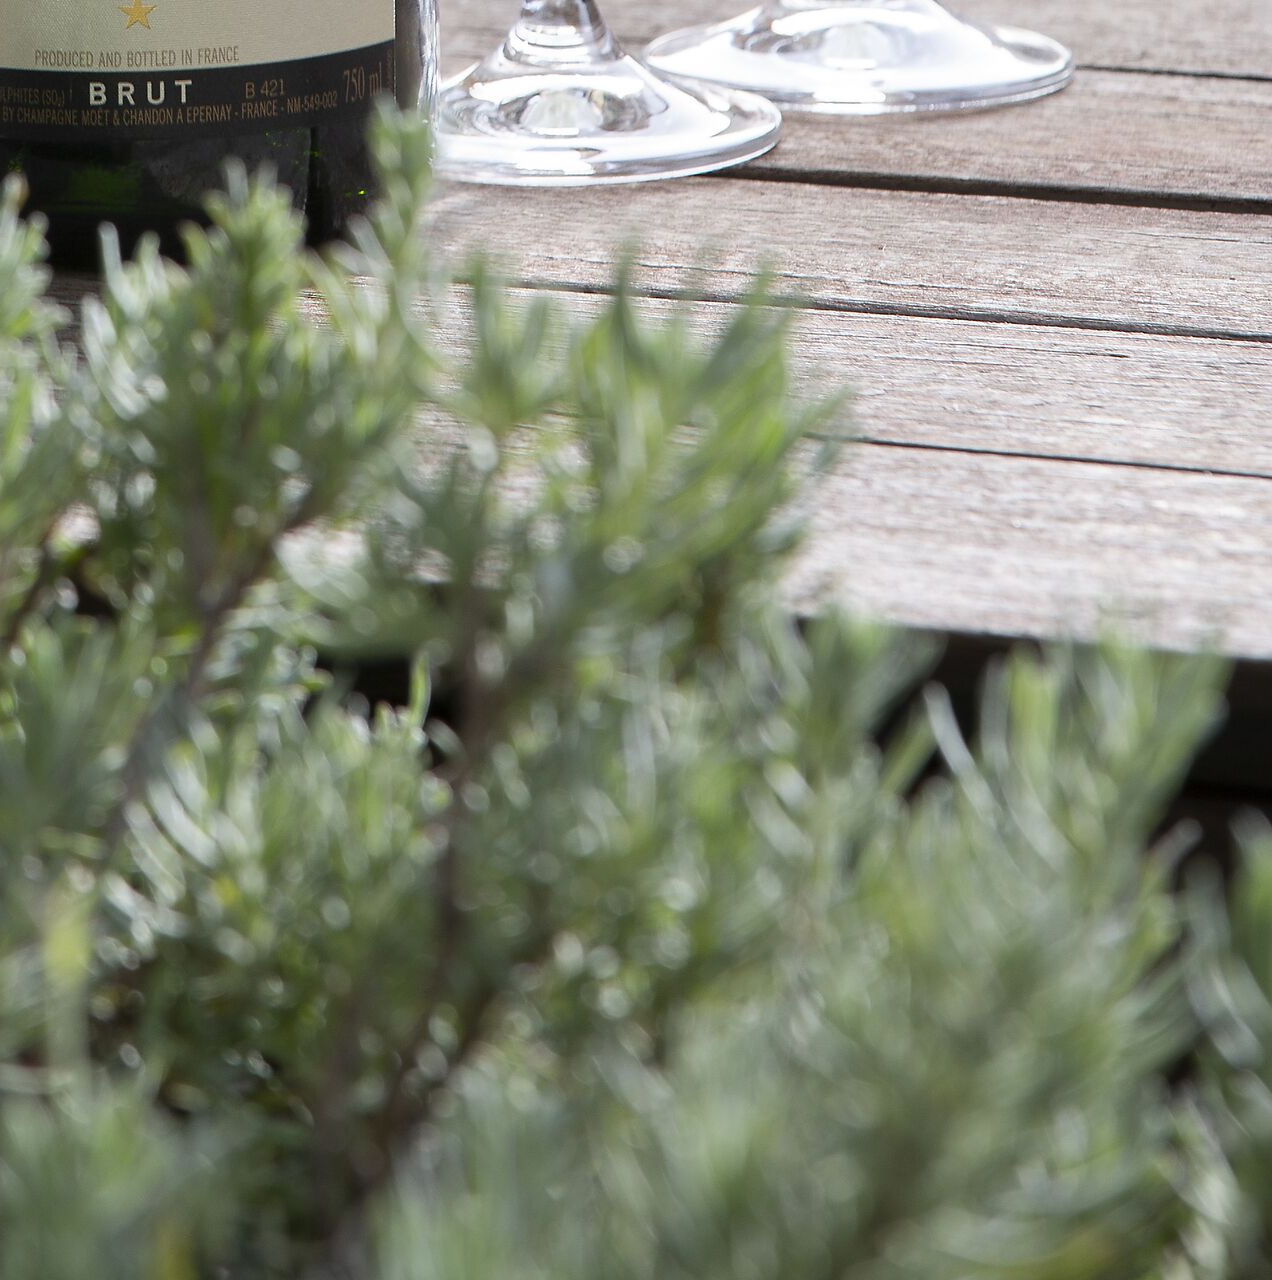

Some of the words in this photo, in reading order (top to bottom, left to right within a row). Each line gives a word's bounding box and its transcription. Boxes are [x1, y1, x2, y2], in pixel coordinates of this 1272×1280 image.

[34, 49, 94, 68] PRODUCED
[98, 50, 122, 68] AND
[127, 49, 176, 68] BOTTLED
[181, 48, 193, 66] IN
[197, 45, 240, 65] FRANCE
[89, 80, 193, 107] BRUT
[245, 81, 256, 100] B
[260, 78, 285, 98] 421
[344, 65, 366, 104] 750
[369, 61, 383, 97] ml
[2, 105, 16, 123] BY
[17, 106, 79, 126] CHAMPAGNE
[112, 110, 121, 127] &
[122, 107, 173, 127] CHANDON
[186, 103, 233, 124] EPERNAY
[241, 99, 279, 120] FRANCE
